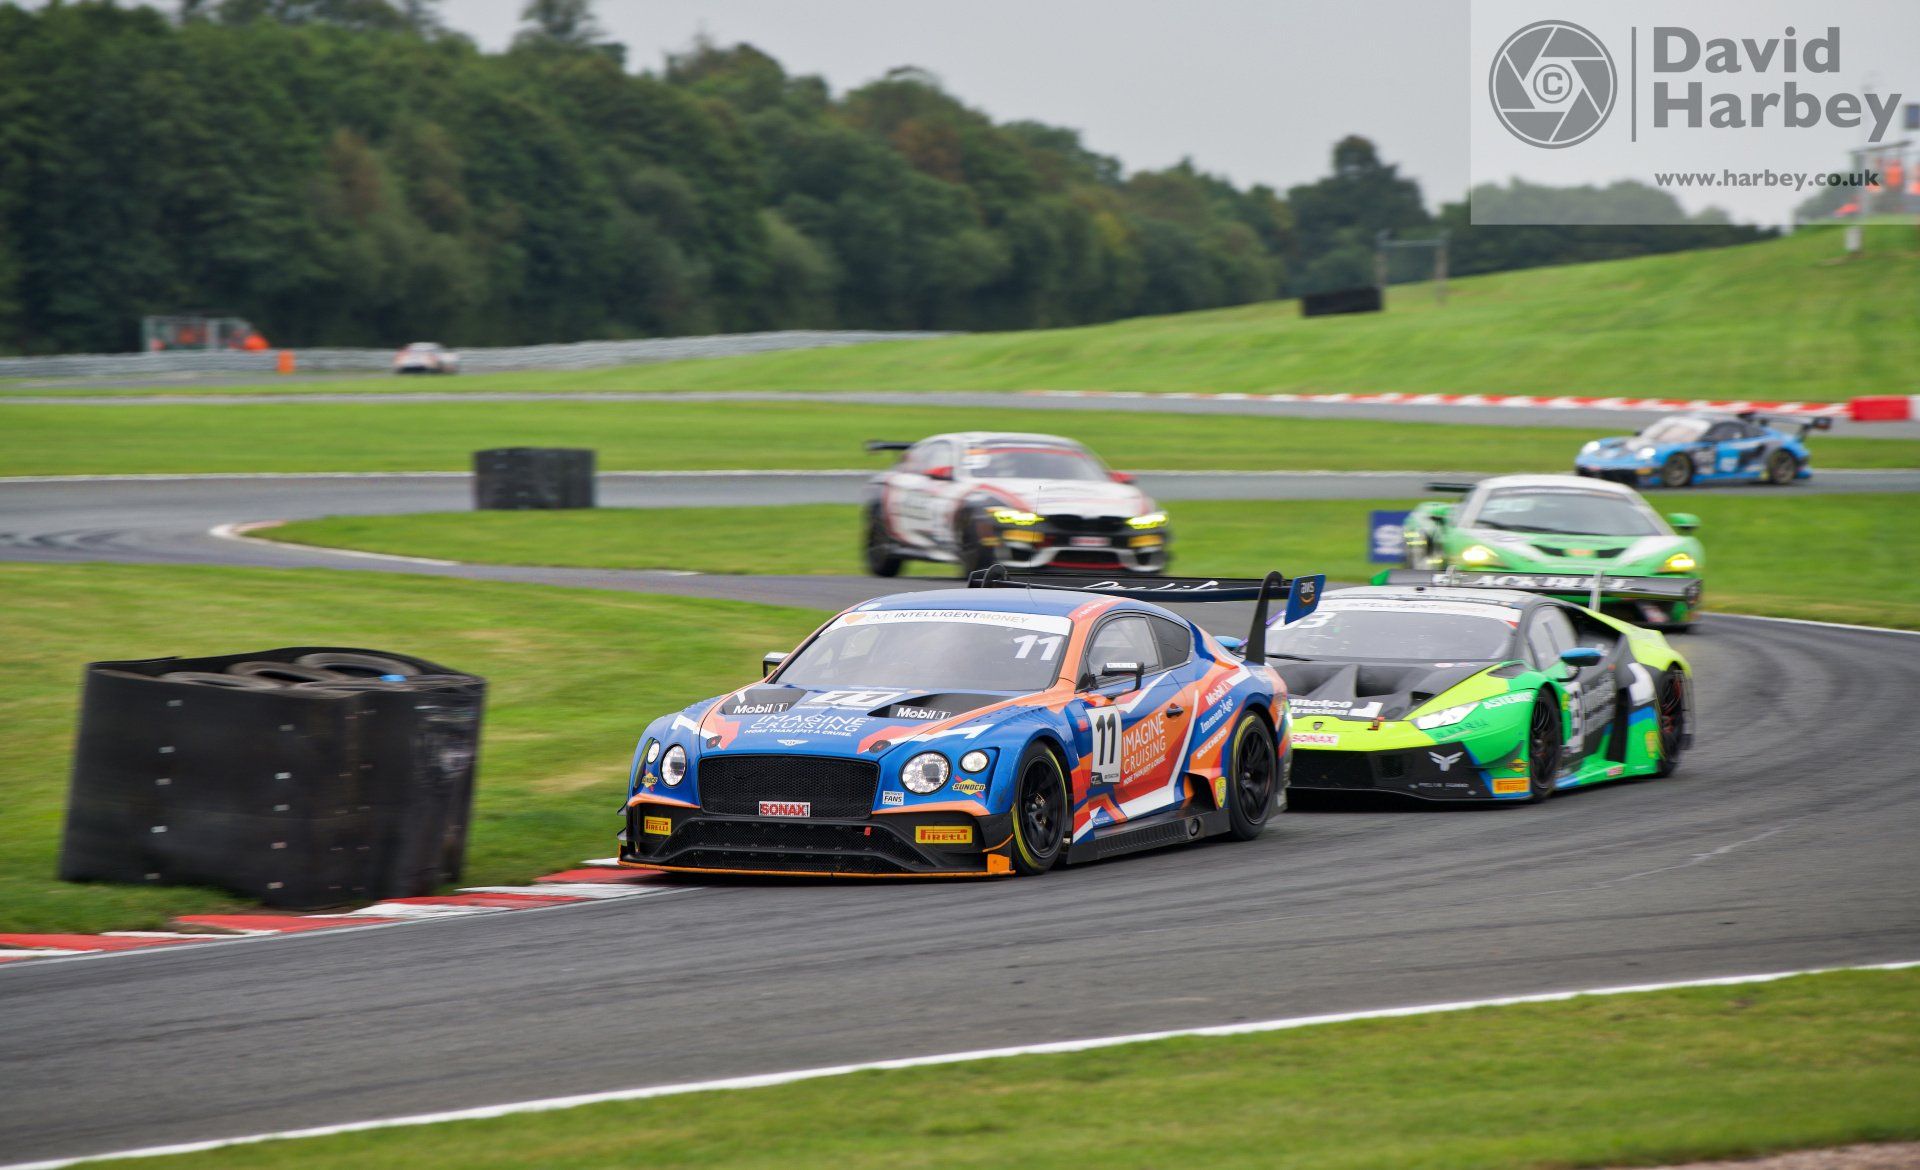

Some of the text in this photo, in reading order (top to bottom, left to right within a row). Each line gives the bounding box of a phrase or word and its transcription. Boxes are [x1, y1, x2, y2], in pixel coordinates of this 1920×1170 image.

[1013, 634, 1065, 661] 11
[733, 704, 772, 714] Mobil
[896, 707, 935, 720] Mobil
[750, 722, 859, 732] CRUISING
[757, 714, 868, 727] IMAGINE
[1095, 712, 1117, 766] 11
[1122, 712, 1165, 758] IMAGINE
[1123, 736, 1166, 775] CRUISING
[884, 795, 902, 803] FANS
[760, 803, 806, 816] SONAX
[646, 820, 669, 832] PIRELLI
[920, 829, 968, 841] PIRELLI
